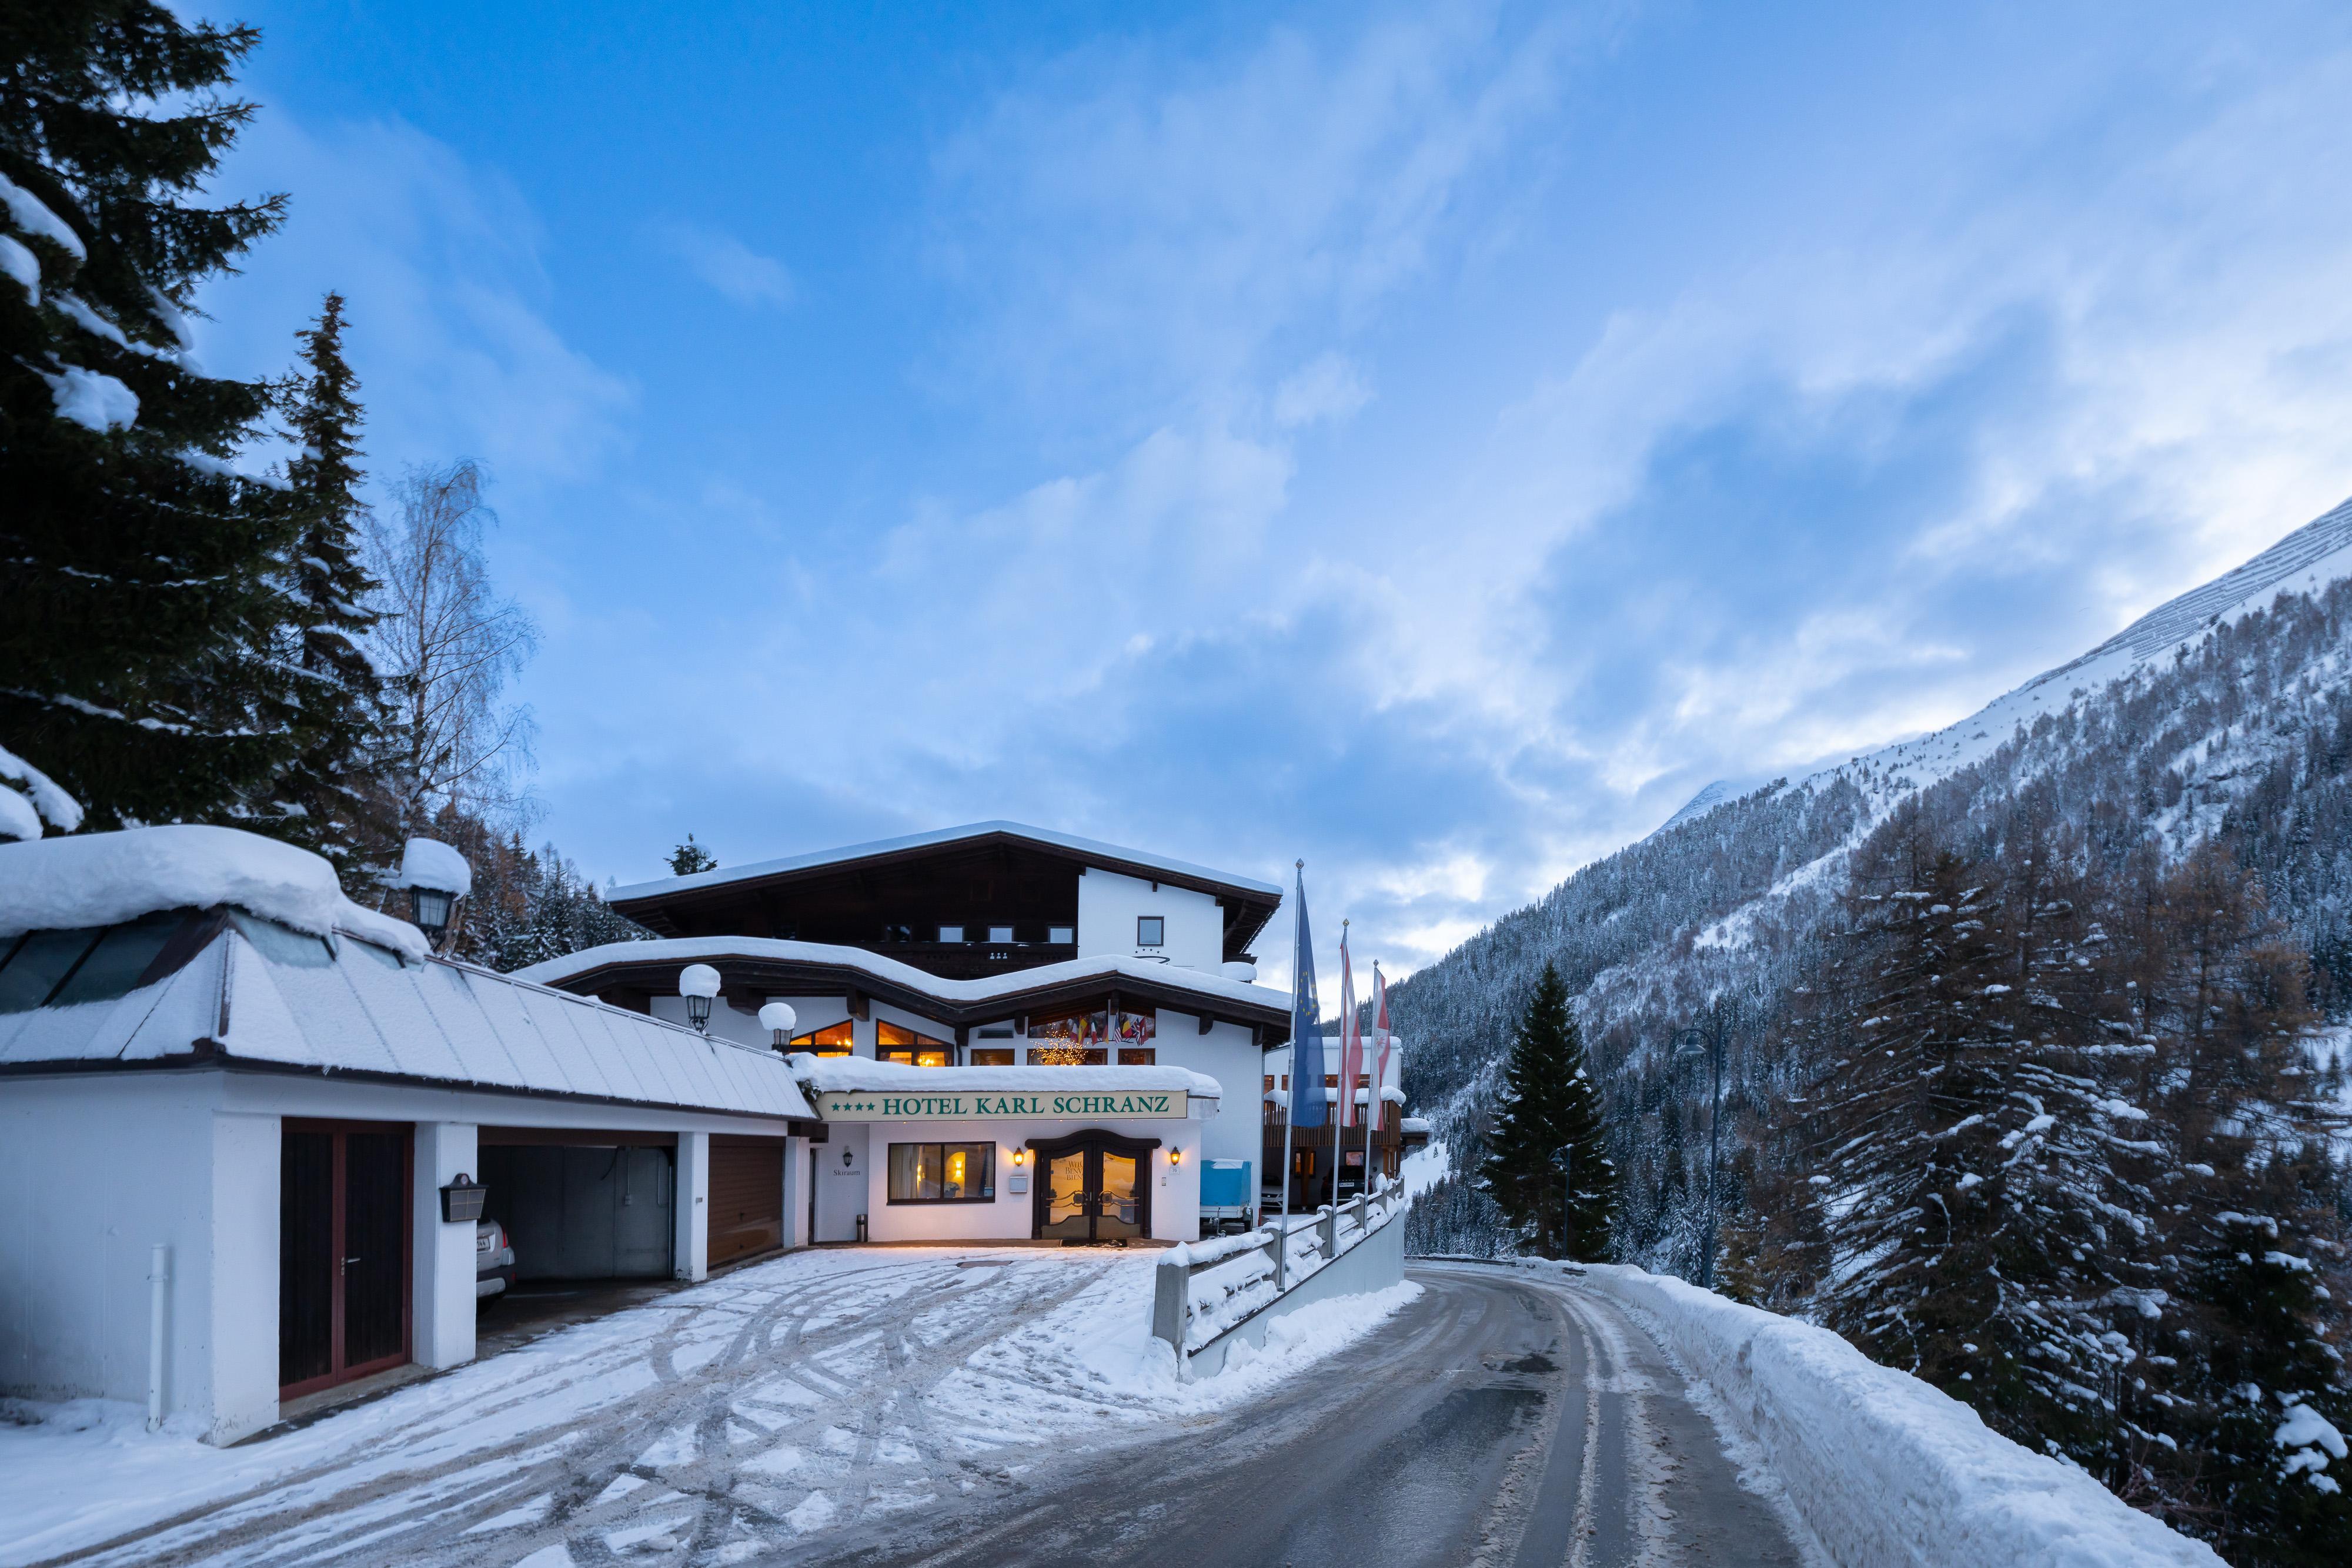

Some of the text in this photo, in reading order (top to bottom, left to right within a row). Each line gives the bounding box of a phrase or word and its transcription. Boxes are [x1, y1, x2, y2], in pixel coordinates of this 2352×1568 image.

[882, 1096, 1170, 1115] HOTEL KARL SCHRANZ
